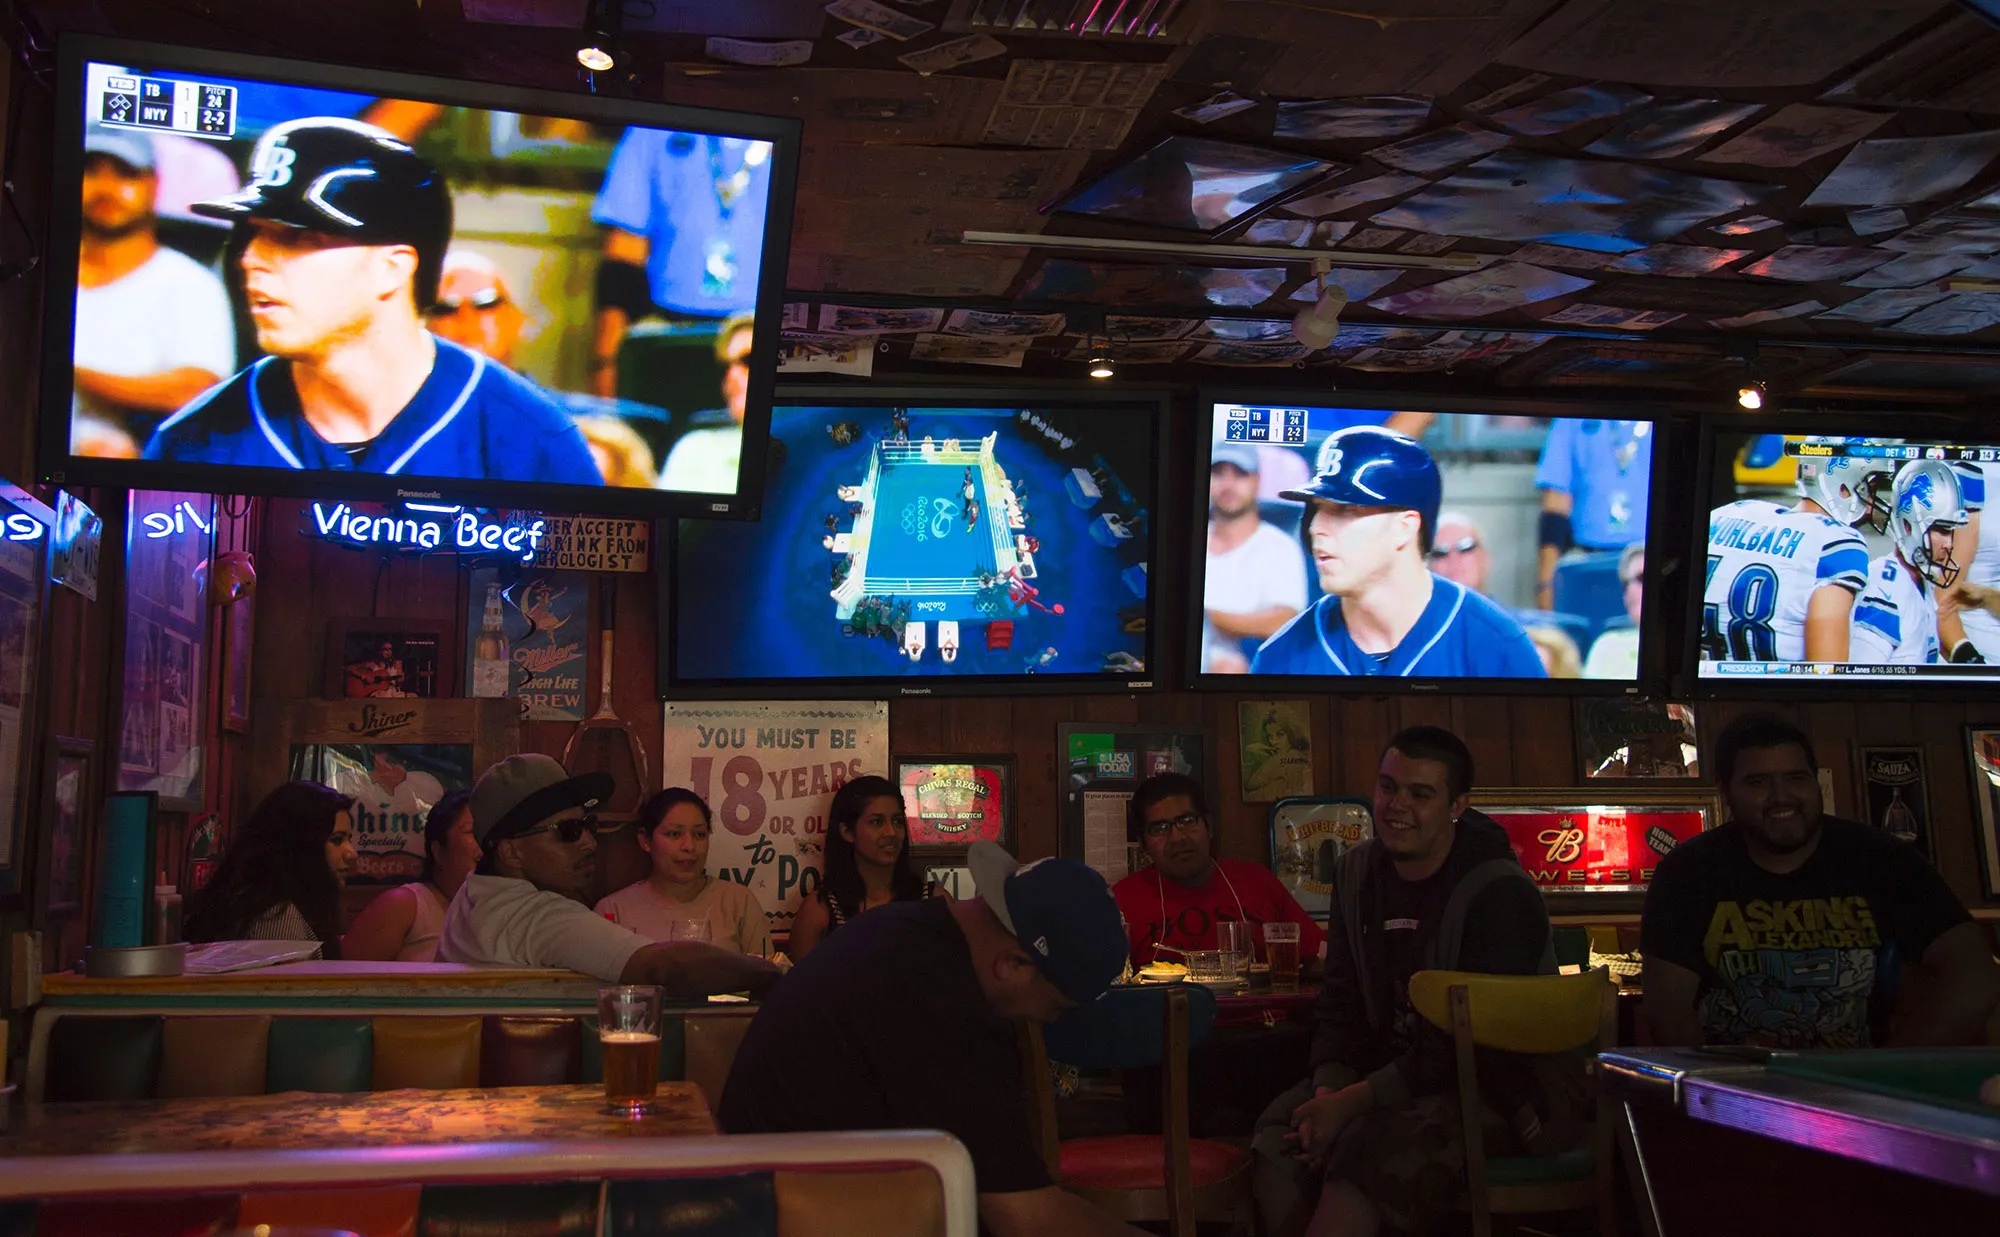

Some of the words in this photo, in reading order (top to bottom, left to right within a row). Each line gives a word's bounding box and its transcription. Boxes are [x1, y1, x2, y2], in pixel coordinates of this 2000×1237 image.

[109, 77, 135, 90] YES
[145, 84, 161, 97] TB
[205, 87, 226, 96] PITCH
[207, 95, 223, 108] 24
[143, 107, 168, 121] NYY
[203, 111, 225, 125] 2-2
[1252, 412, 1261, 421] TB
[1289, 417, 1299, 425] 24
[1251, 428, 1265, 437] NYY
[1287, 427, 1300, 437] 2-2
[1799, 443, 1833, 457] Steelers
[1885, 448, 1899, 457] DET
[1960, 450, 1974, 459] PIT
[397, 489, 441, 500] Panasonic
[313, 502, 440, 548] Vienna
[456, 513, 544, 561] Beef
[576, 520, 635, 536] ACCEPT
[544, 537, 602, 553] DRINK
[606, 537, 645, 553] FROM
[1882, 560, 1898, 581] 5
[513, 643, 581, 670] Miller
[1720, 663, 1765, 673] PRESEASON
[1792, 665, 1801, 673] 10
[1804, 665, 1813, 674] 14
[554, 673, 579, 689] LIFE
[901, 687, 931, 695] Panasonic
[519, 693, 581, 708] BREW
[349, 704, 417, 735] Shiner
[697, 725, 746, 749] YOU
[757, 727, 819, 749] MUST
[830, 728, 857, 749] BE
[1108, 753, 1130, 764] USA
[1097, 763, 1131, 774] TODAY
[1877, 762, 1912, 776] SAUZA
[918, 778, 952, 795] CHIVAS
[955, 779, 986, 795] REGAL
[690, 755, 767, 836] 18
[921, 812, 949, 820] BLENDED
[957, 812, 982, 820] SCOTCH
[769, 816, 796, 835] OR
[937, 823, 967, 833] WHISKY
[358, 834, 408, 849] Specialty
[1651, 826, 1678, 849] HOME
[744, 834, 775, 866] to
